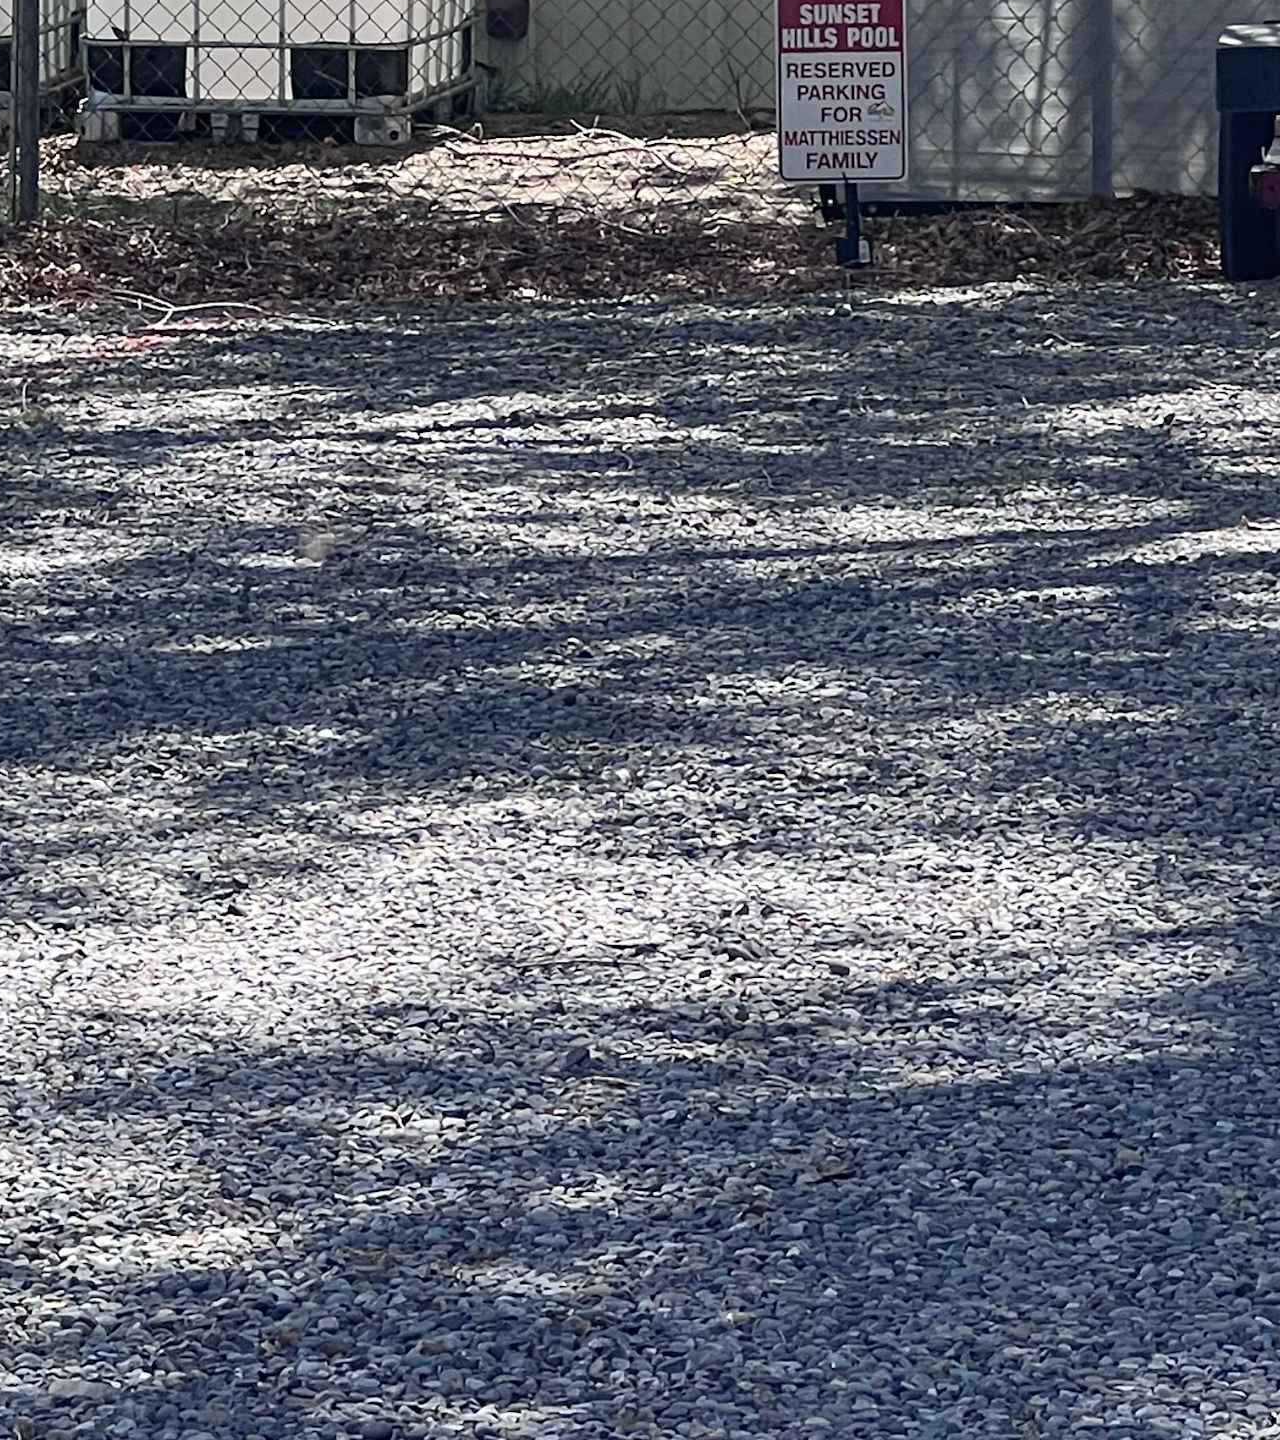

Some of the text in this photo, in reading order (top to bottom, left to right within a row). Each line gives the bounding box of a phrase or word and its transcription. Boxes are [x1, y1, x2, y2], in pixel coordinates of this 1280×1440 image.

[799, 3, 881, 25] SUNSET
[782, 27, 900, 48] HILLS POOL
[786, 61, 895, 78] RESERVED
[797, 84, 886, 101] PARKING
[821, 107, 862, 122] FOR
[784, 129, 901, 146] MATTHIESSEN
[806, 152, 878, 169] FAMILY
